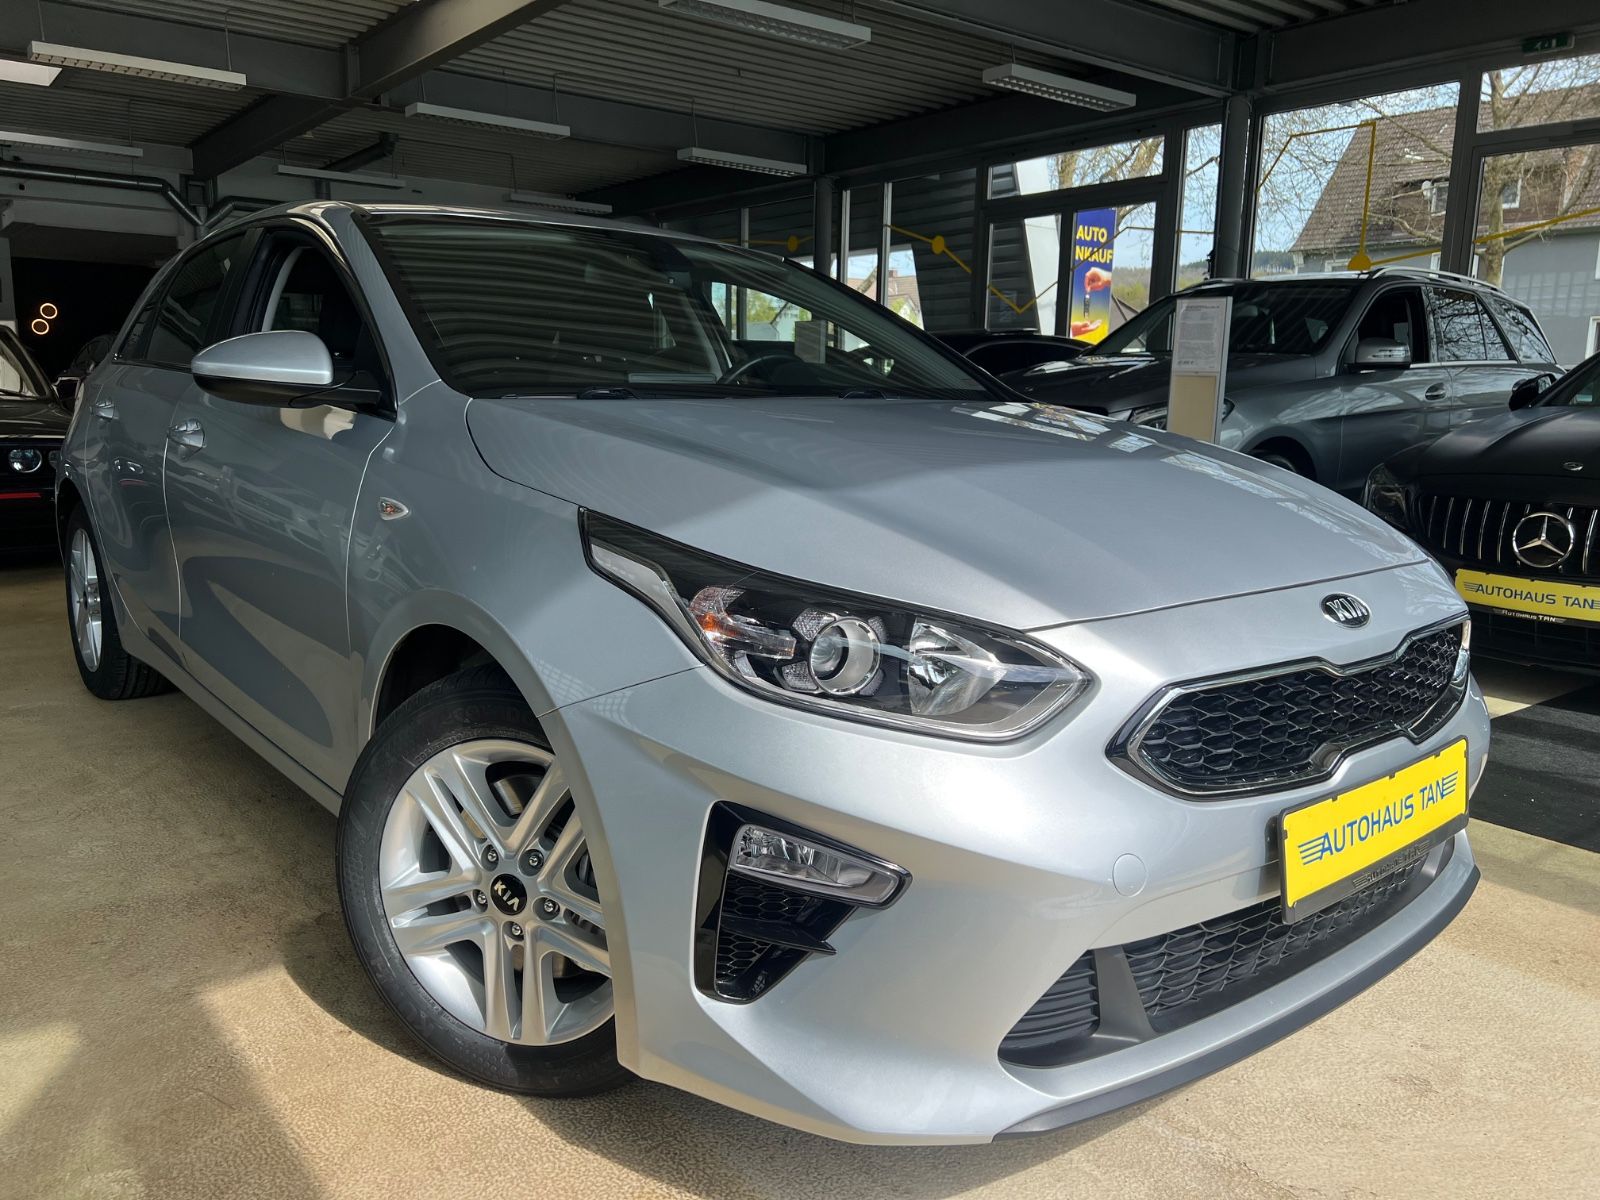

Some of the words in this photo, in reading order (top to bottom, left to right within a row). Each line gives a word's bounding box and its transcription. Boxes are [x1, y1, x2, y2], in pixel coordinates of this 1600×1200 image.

[1076, 225, 1108, 243] AUTO
[1074, 245, 1113, 264] NKAUF
[1326, 597, 1368, 622] KIA
[1475, 584, 1558, 605] AUTOHAUS
[1562, 596, 1595, 610] TAN
[1538, 614, 1556, 623] TAN
[1319, 793, 1415, 861] AUTOHAUS
[1419, 777, 1446, 811] TAN
[493, 880, 520, 911] KIA
